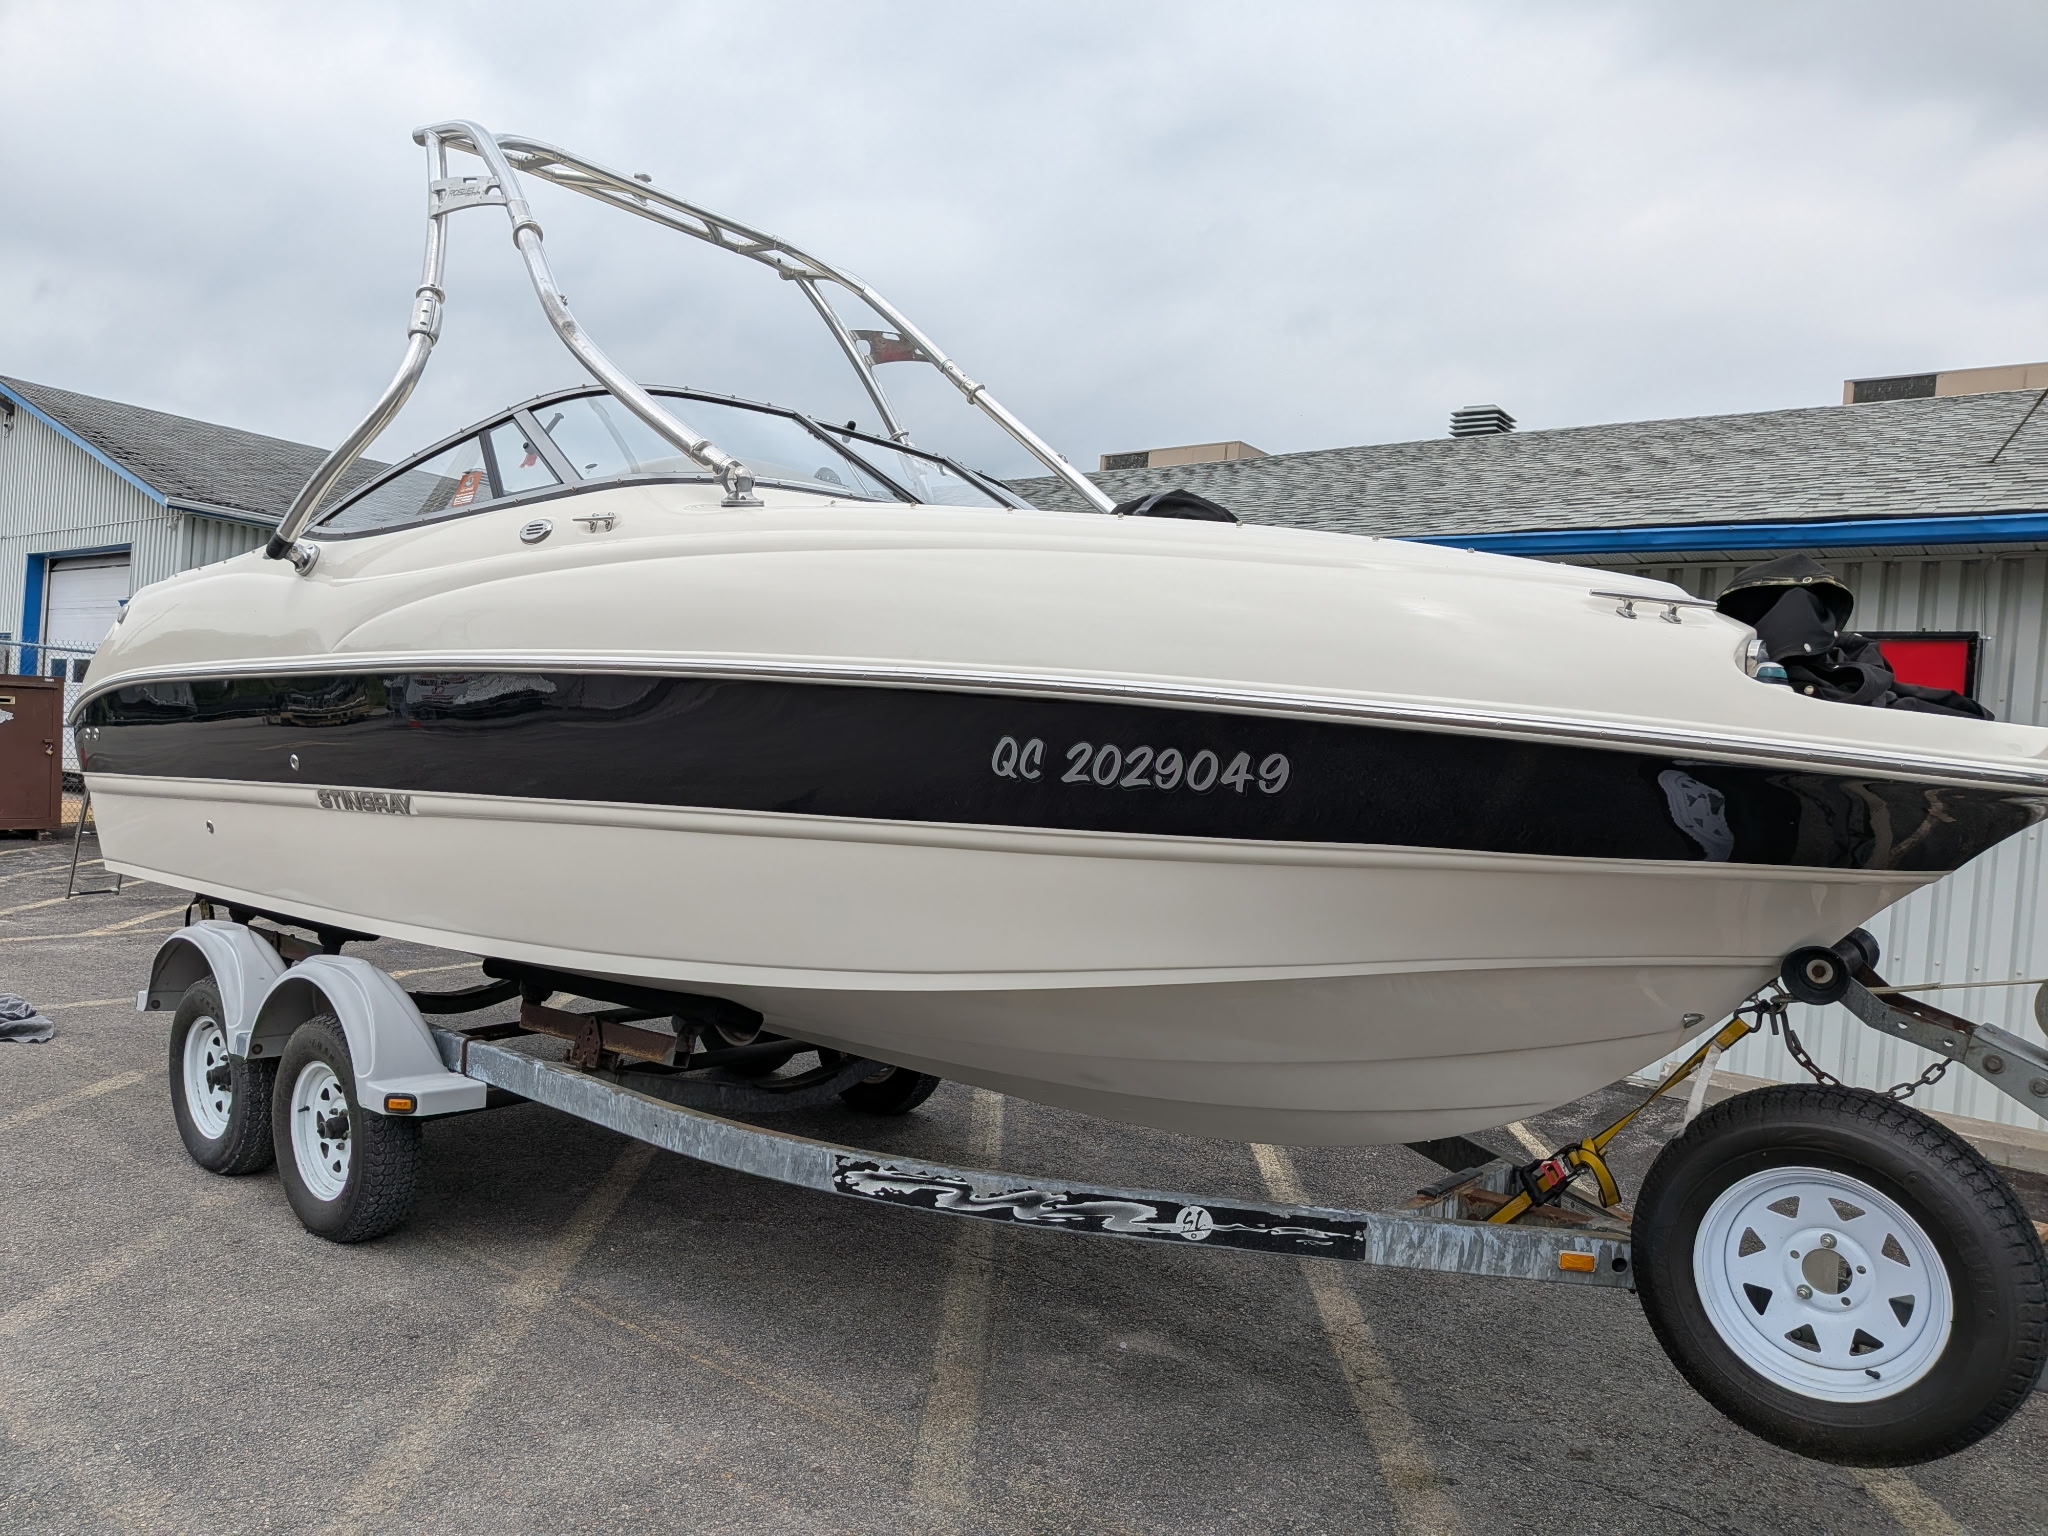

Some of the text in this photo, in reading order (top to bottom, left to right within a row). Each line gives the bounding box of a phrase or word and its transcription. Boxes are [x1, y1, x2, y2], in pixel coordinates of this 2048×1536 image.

[990, 736, 1291, 794] QC 2029049
[317, 788, 411, 815] STINGRAY
